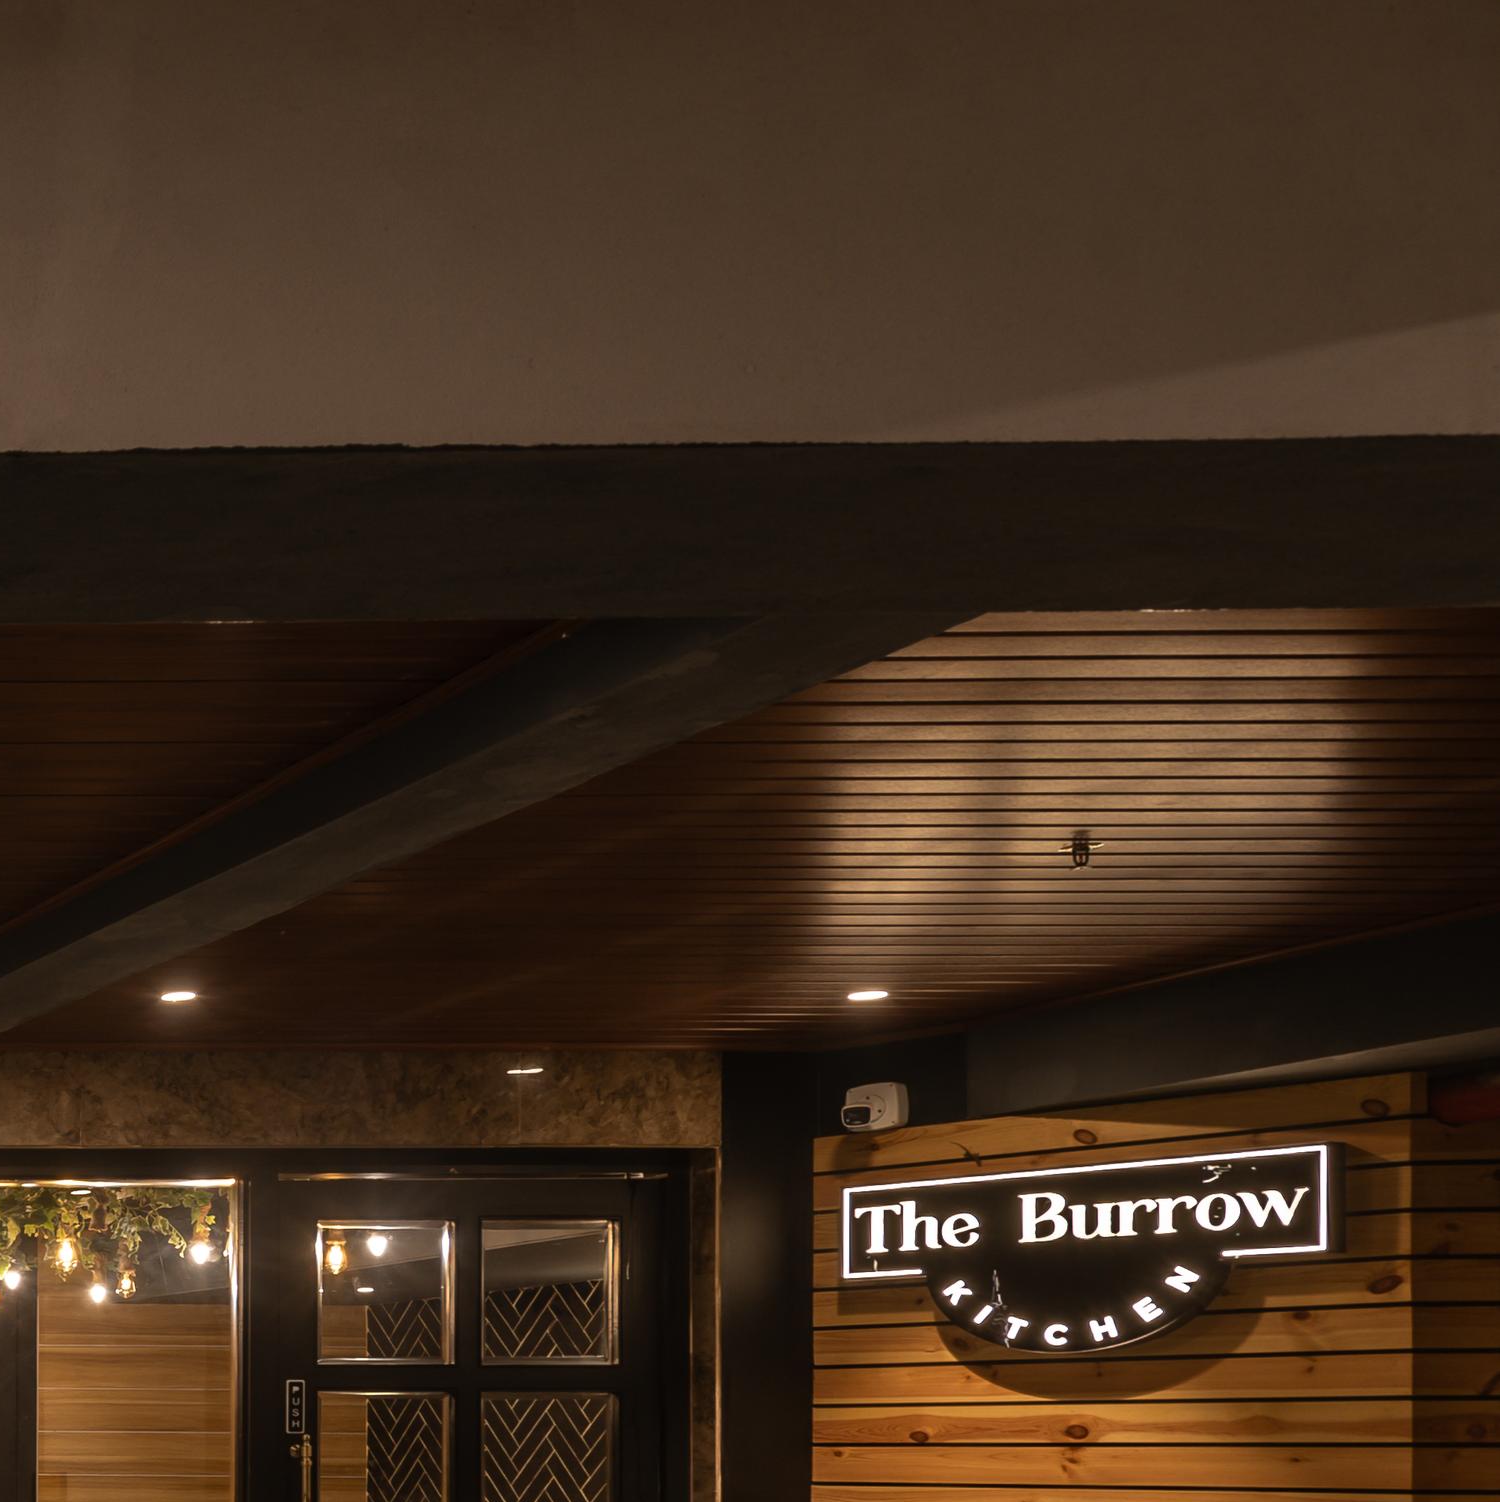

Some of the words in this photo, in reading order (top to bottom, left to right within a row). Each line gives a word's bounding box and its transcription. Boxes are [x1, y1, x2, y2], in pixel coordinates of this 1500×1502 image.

[854, 1199, 981, 1254] The
[1017, 1186, 1310, 1244] Burrow
[942, 1264, 1201, 1346] KITCHEN
[291, 1385, 301, 1428] PUSH
